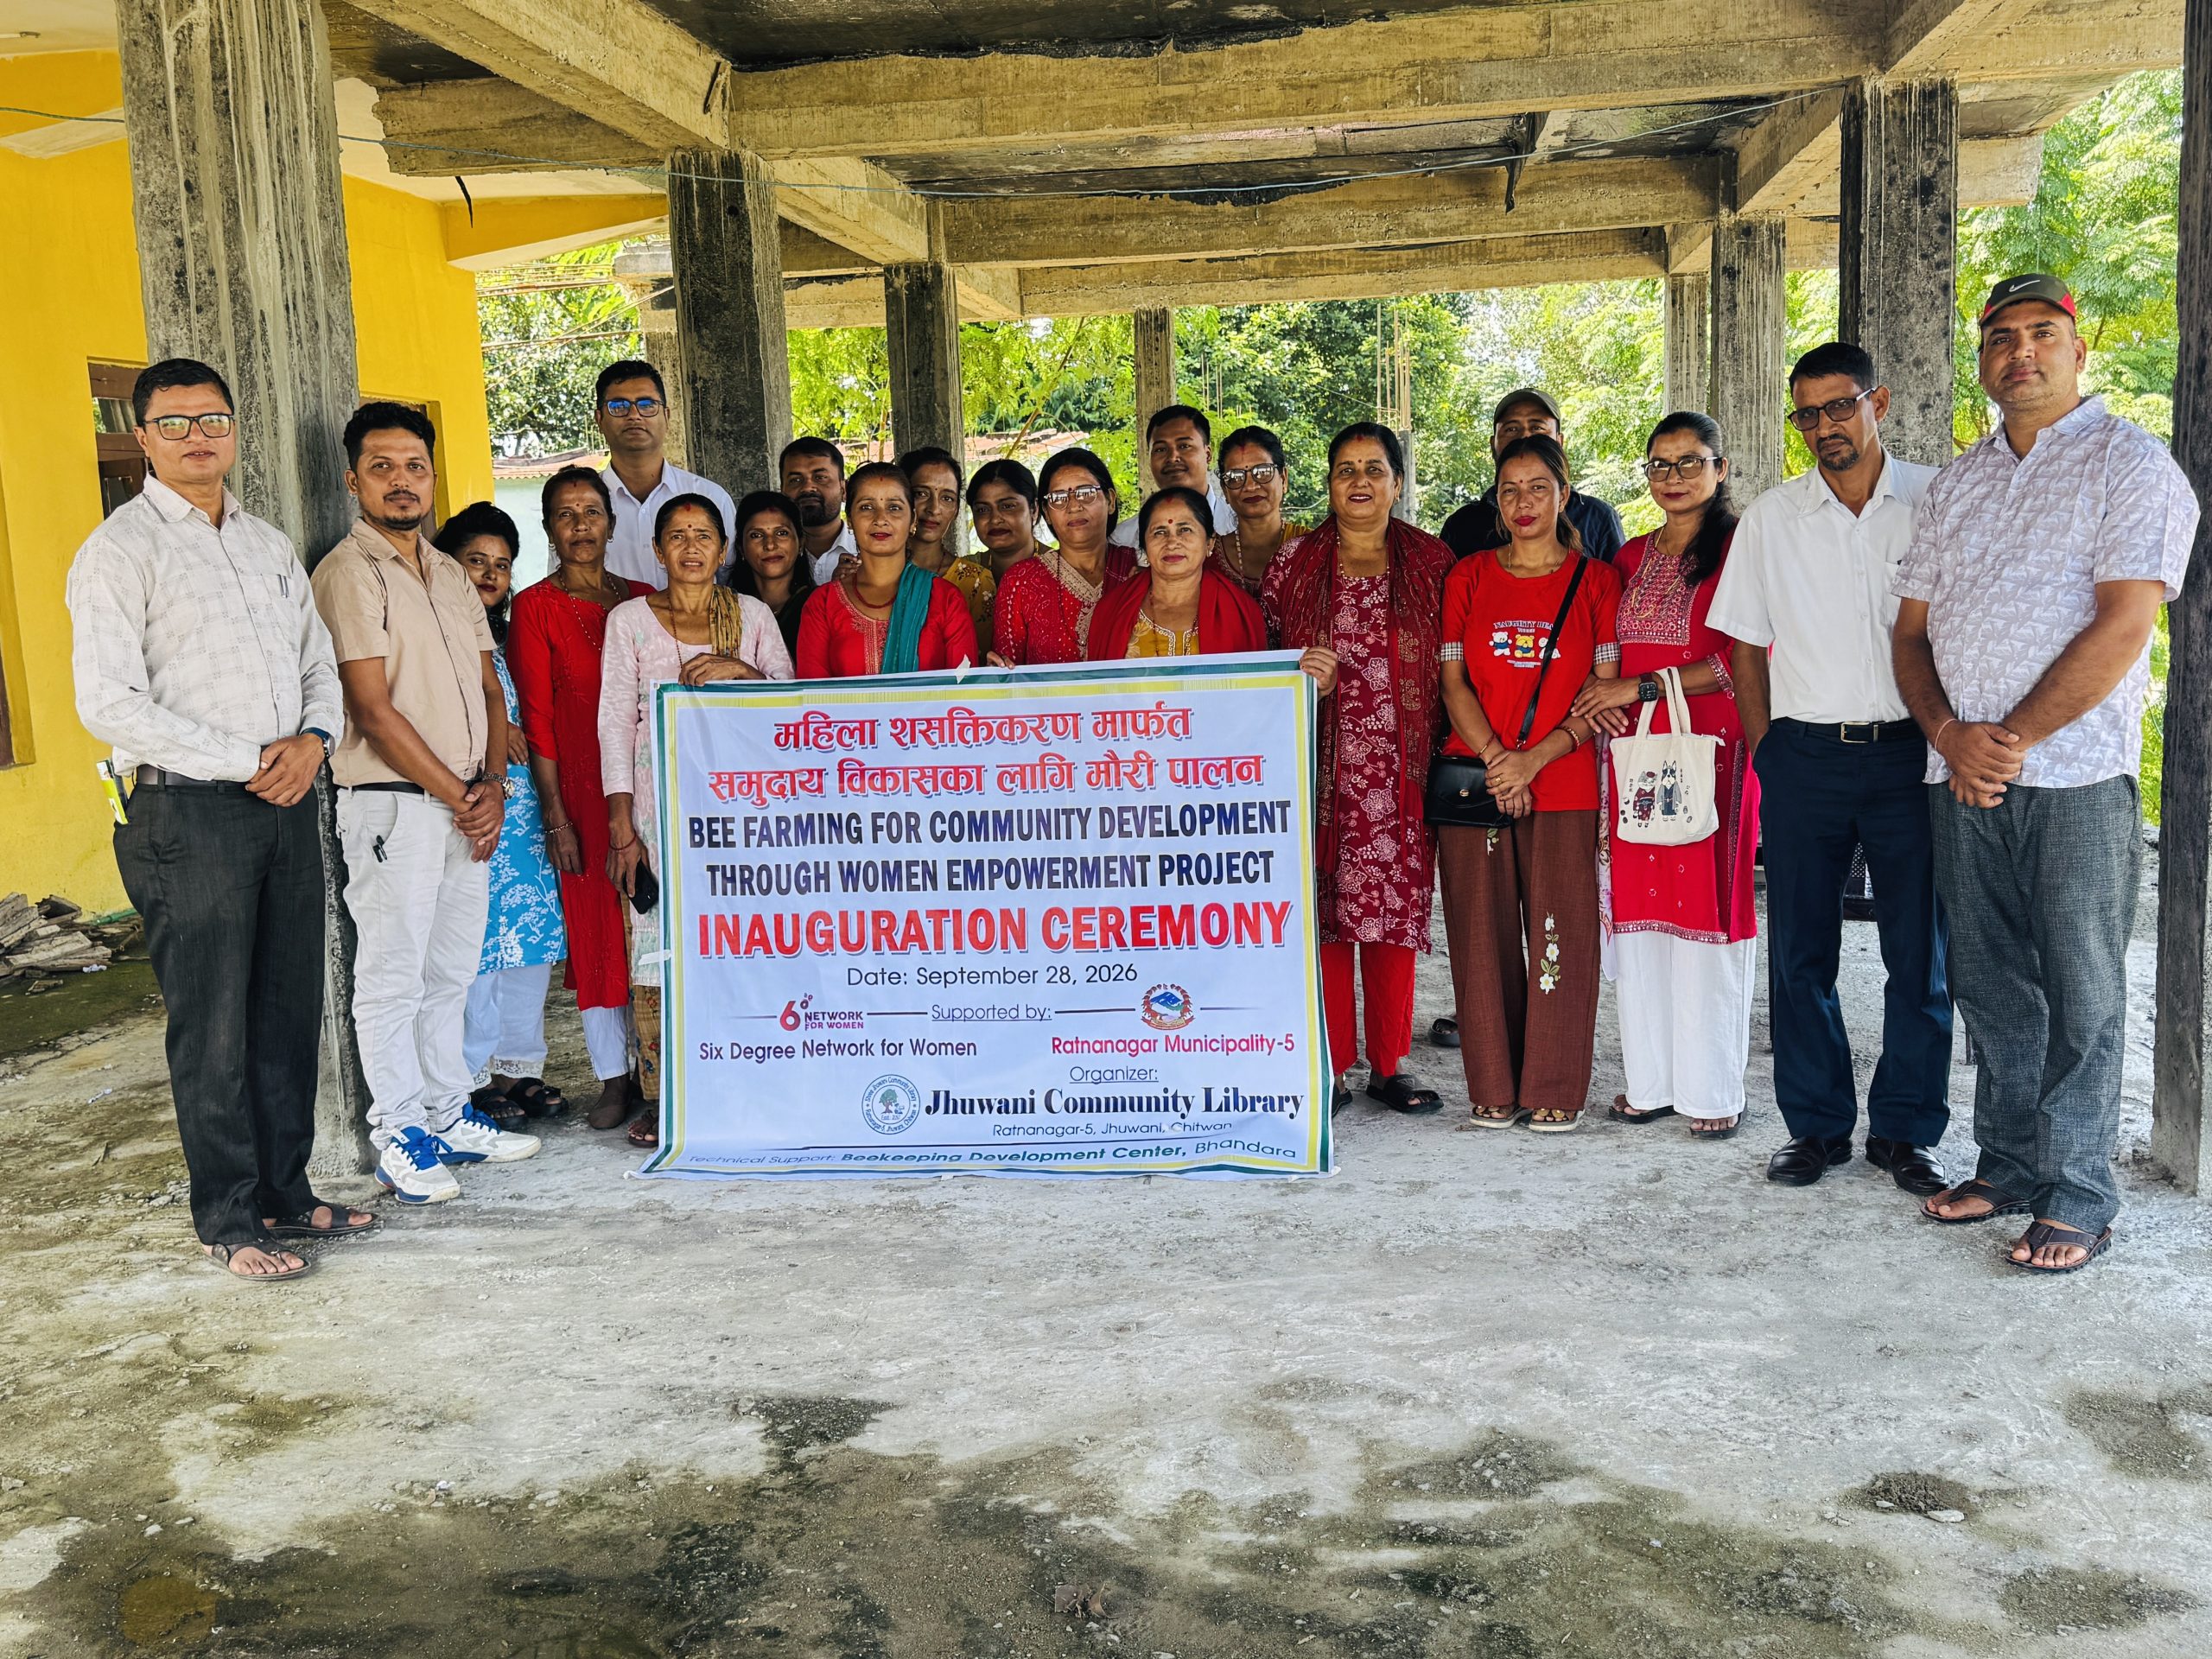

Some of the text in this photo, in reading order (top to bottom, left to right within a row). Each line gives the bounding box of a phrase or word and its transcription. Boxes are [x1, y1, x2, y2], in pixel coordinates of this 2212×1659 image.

[773, 701, 1193, 751] महिला शसक्तिकरण मार्फत
[708, 750, 1265, 807] समुदाय विकासका लागि मौरी पालन
[689, 800, 1291, 849] BEE FARMING FOR COMMUNITY DEVELOPMENT
[707, 850, 1274, 896] THROUGH WOMEN EMPOWERMENT PROJECT
[698, 899, 1293, 958] INAUGURATION CEREMONY
[847, 963, 1138, 988] Date: September 28, 2026
[804, 1011, 864, 1022] NETWORK
[931, 1003, 1052, 1021] Supported by:
[804, 1021, 864, 1031] FOR WOMEN
[699, 1038, 977, 1064] Six Degree Network for Women
[1052, 1033, 1294, 1058] Ratnanagar Municipality-5
[1070, 1065, 1159, 1085] Organizer:
[925, 1086, 1305, 1120] Jhuwani Community Library
[993, 1122, 1232, 1138] Ratnanagar-5, Jhuwani, Chitwan
[690, 1139, 1296, 1164] Technical Support: Beekeeping Development Center, Bhandara
